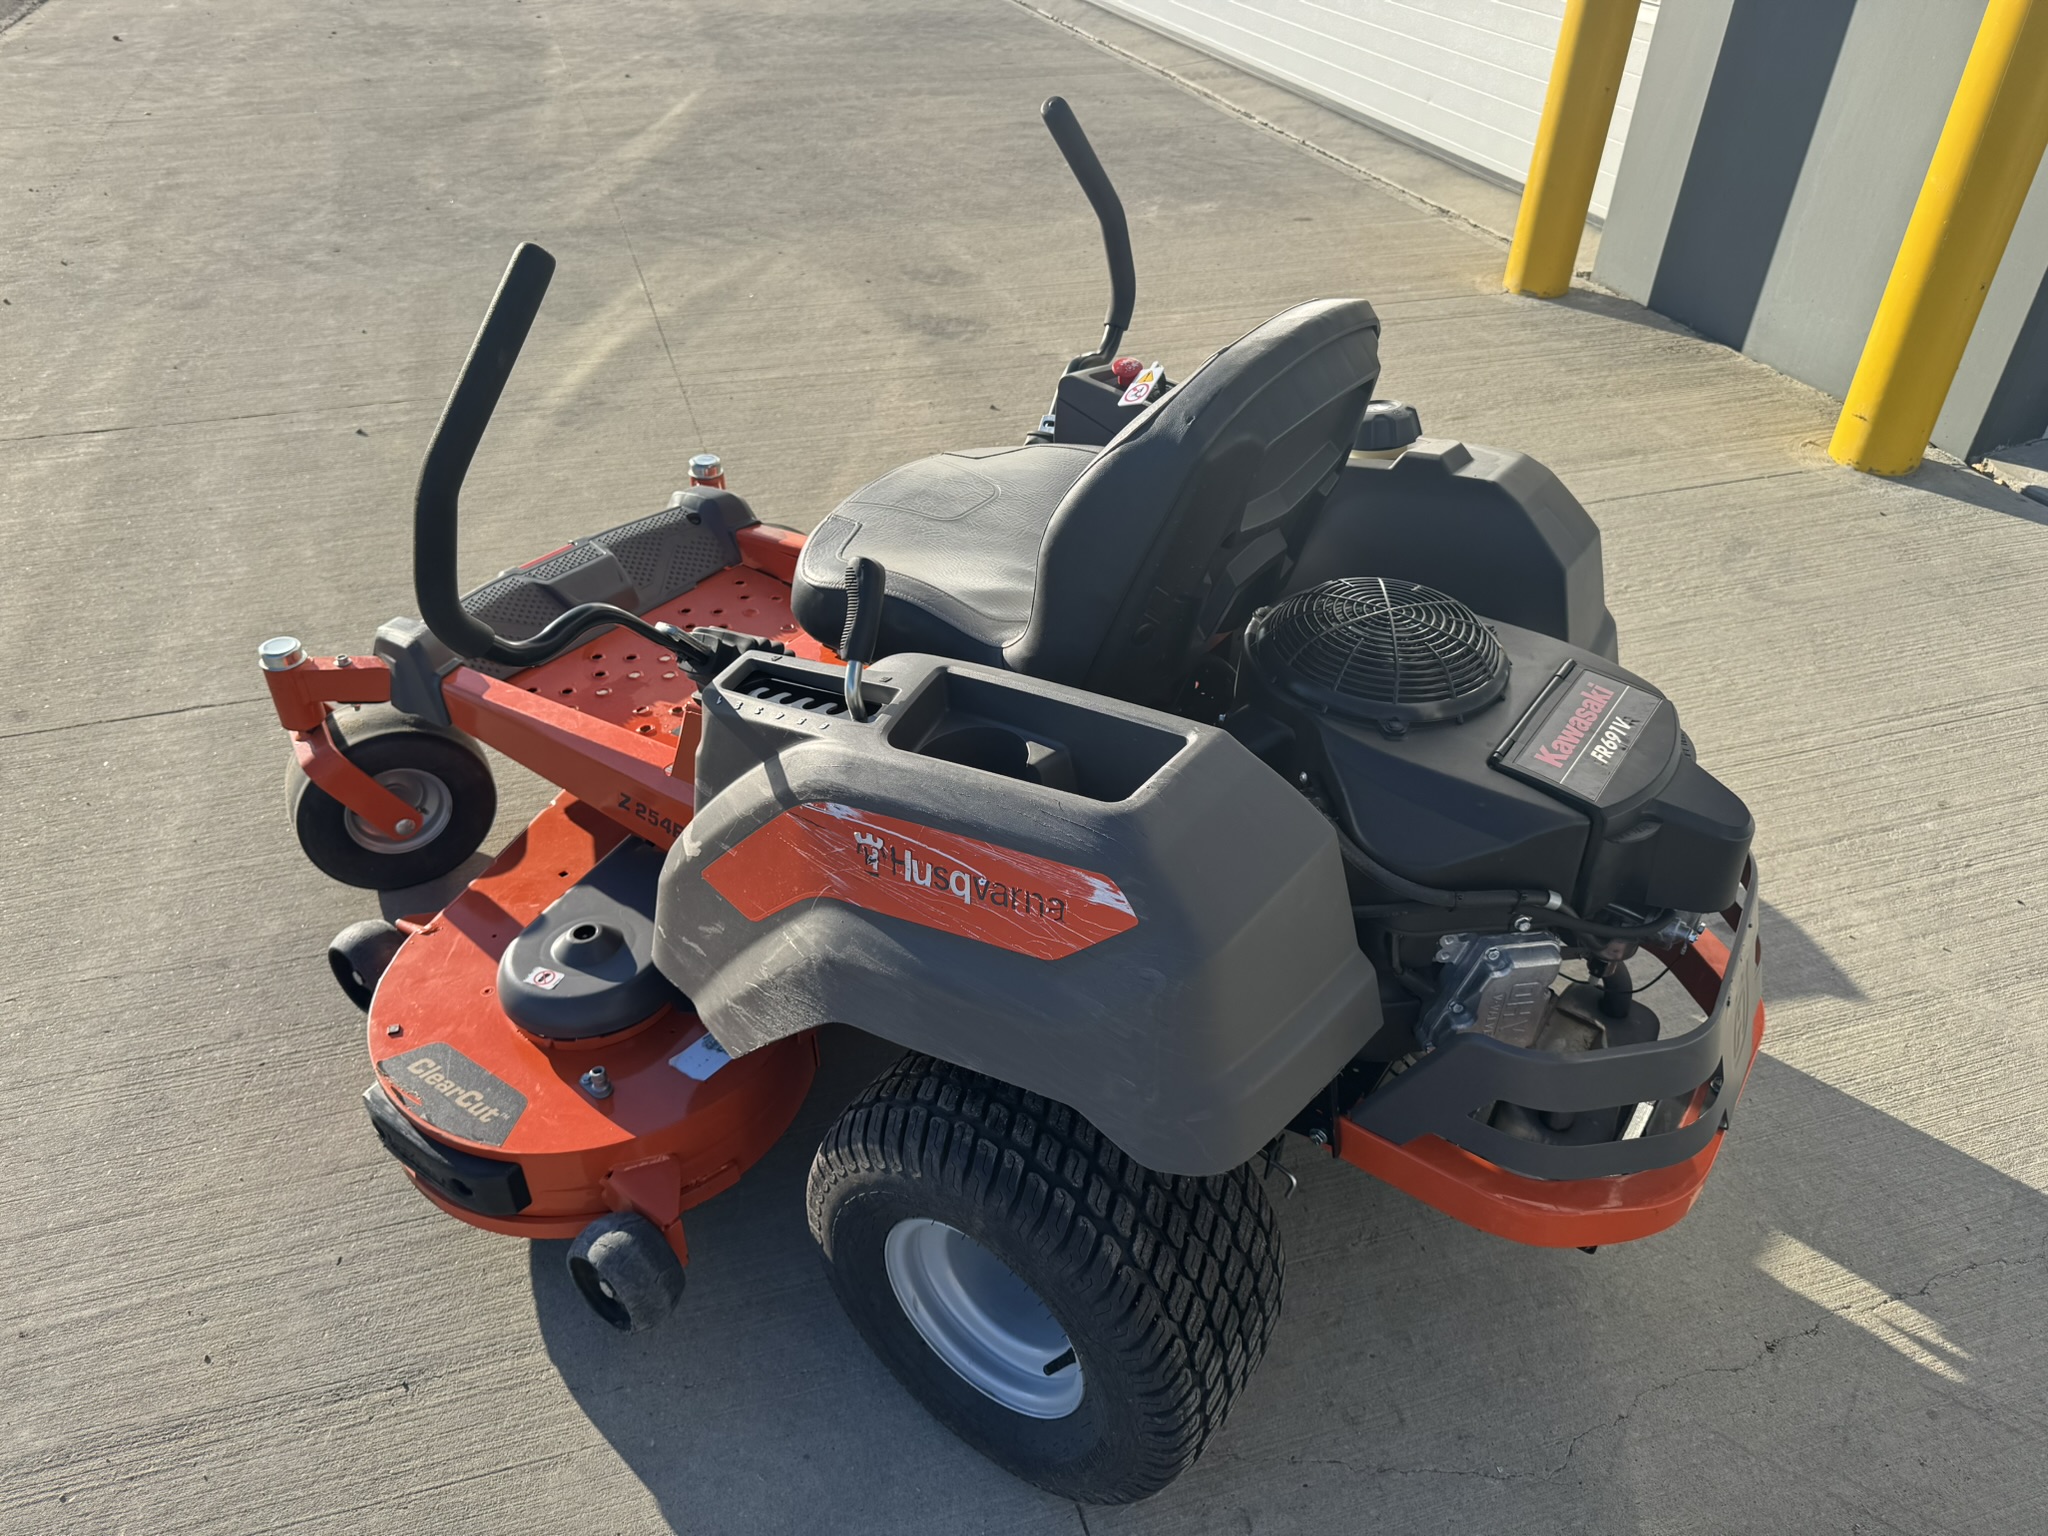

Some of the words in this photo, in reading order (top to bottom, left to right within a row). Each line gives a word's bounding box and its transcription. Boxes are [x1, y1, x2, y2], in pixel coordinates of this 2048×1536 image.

[1534, 682, 1614, 768] Kawasaki
[1590, 715, 1631, 764] FR691V
[618, 792, 631, 811] Z
[892, 848, 1065, 922] Husqvarna
